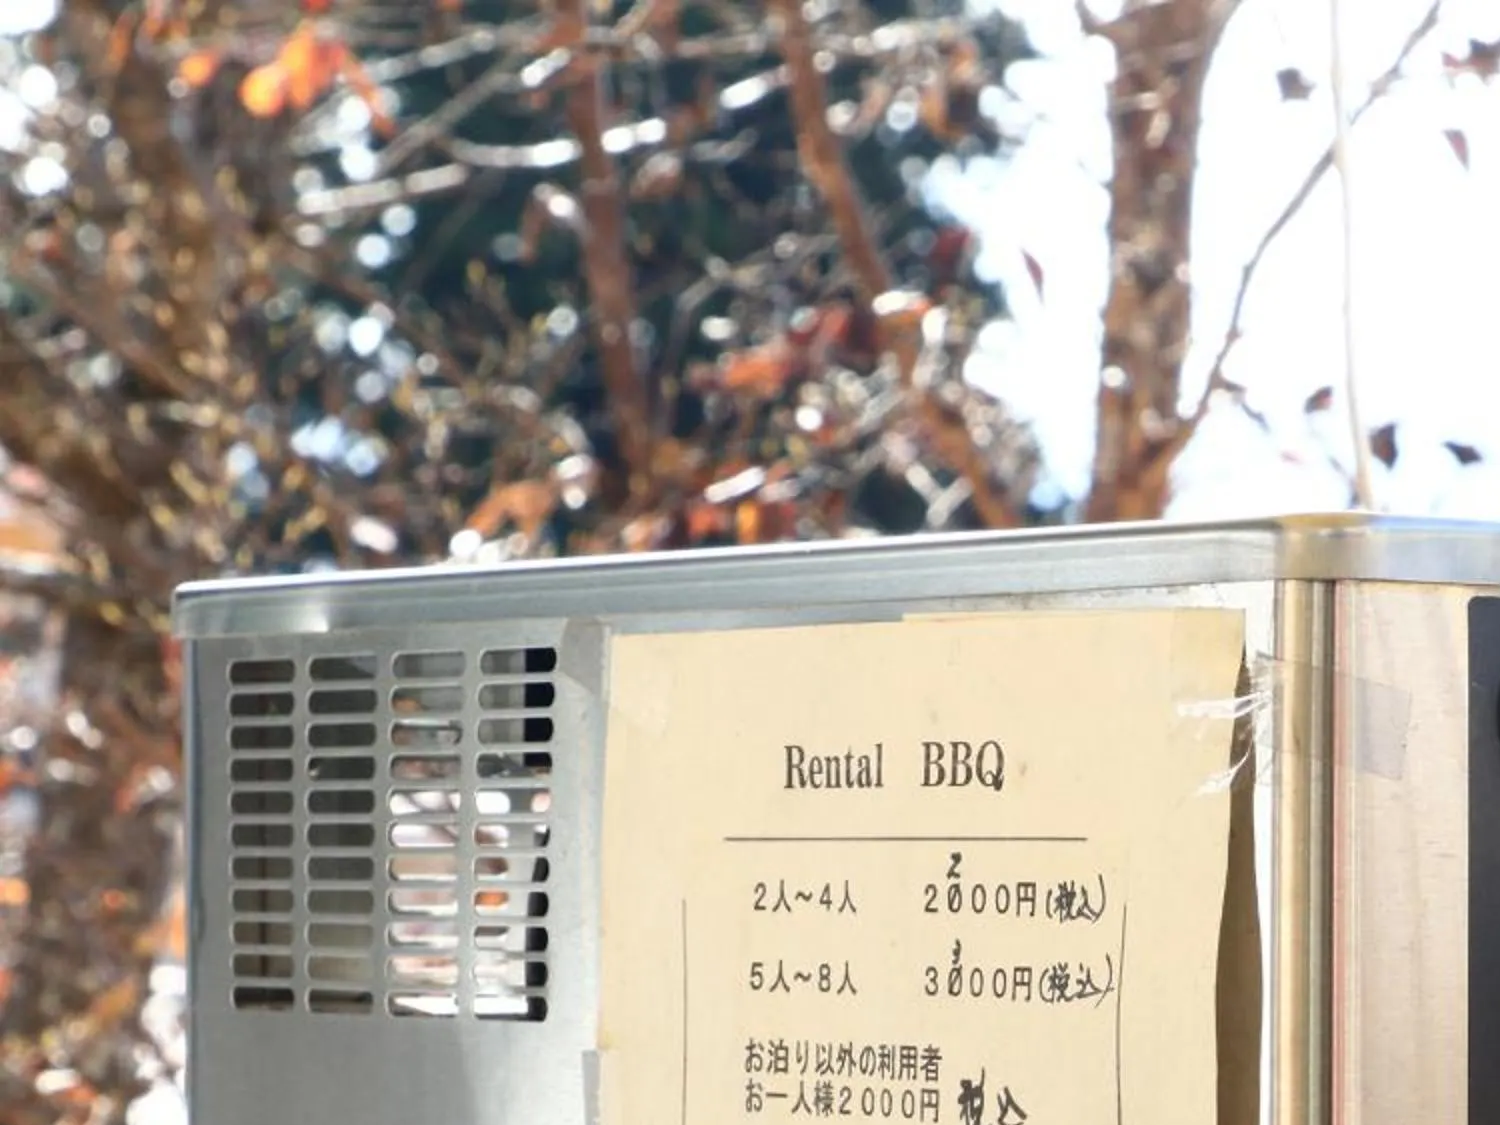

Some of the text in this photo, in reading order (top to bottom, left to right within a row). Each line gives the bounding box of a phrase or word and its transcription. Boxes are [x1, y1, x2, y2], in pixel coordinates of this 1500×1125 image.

[784, 740, 1005, 791] Rental BBQ
[744, 1039, 942, 1082] お泊り以外の利用者
[744, 1079, 940, 1123] お一人様2000円
